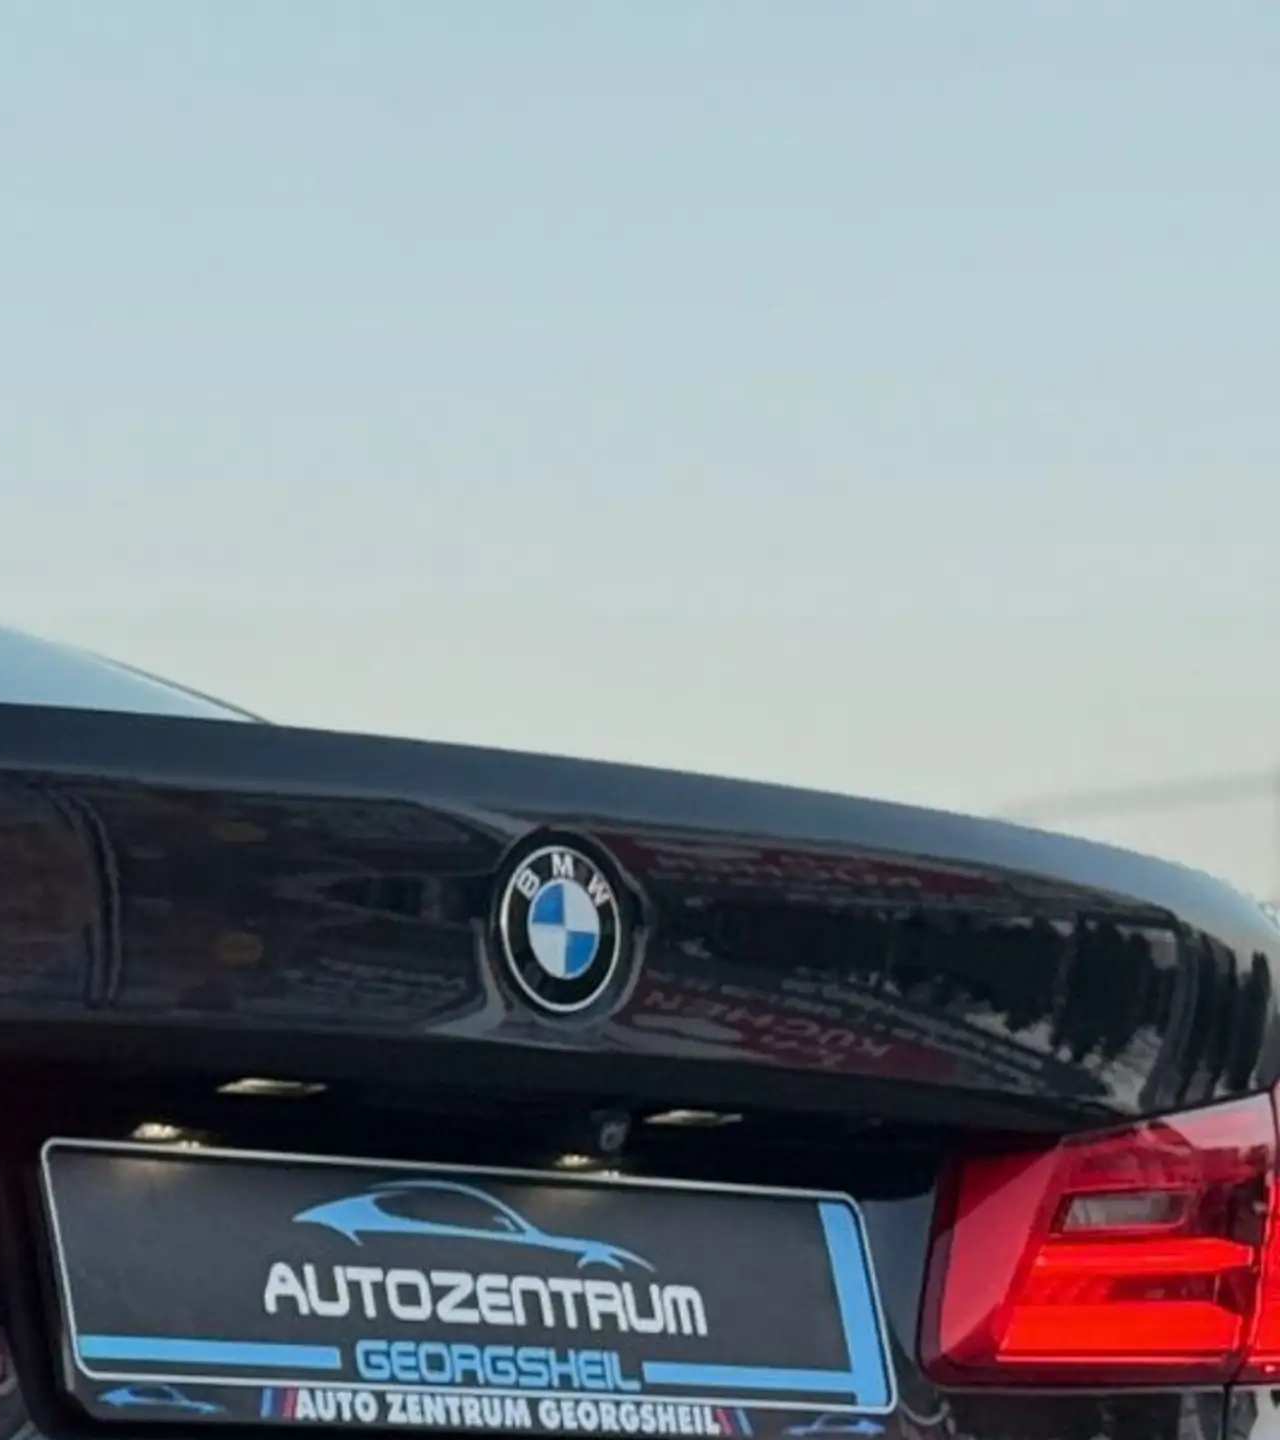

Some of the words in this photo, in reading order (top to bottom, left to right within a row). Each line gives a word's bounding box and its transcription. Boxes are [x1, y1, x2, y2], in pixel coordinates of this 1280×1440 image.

[517, 853, 612, 908] BMW
[263, 1262, 708, 1336] AUTOZENTRUM
[355, 1339, 642, 1391] GEORGSHEIL
[295, 1390, 378, 1424] AUTO
[385, 1393, 532, 1429] ZENTRUM
[537, 1400, 721, 1437] GEORGSHEIL
